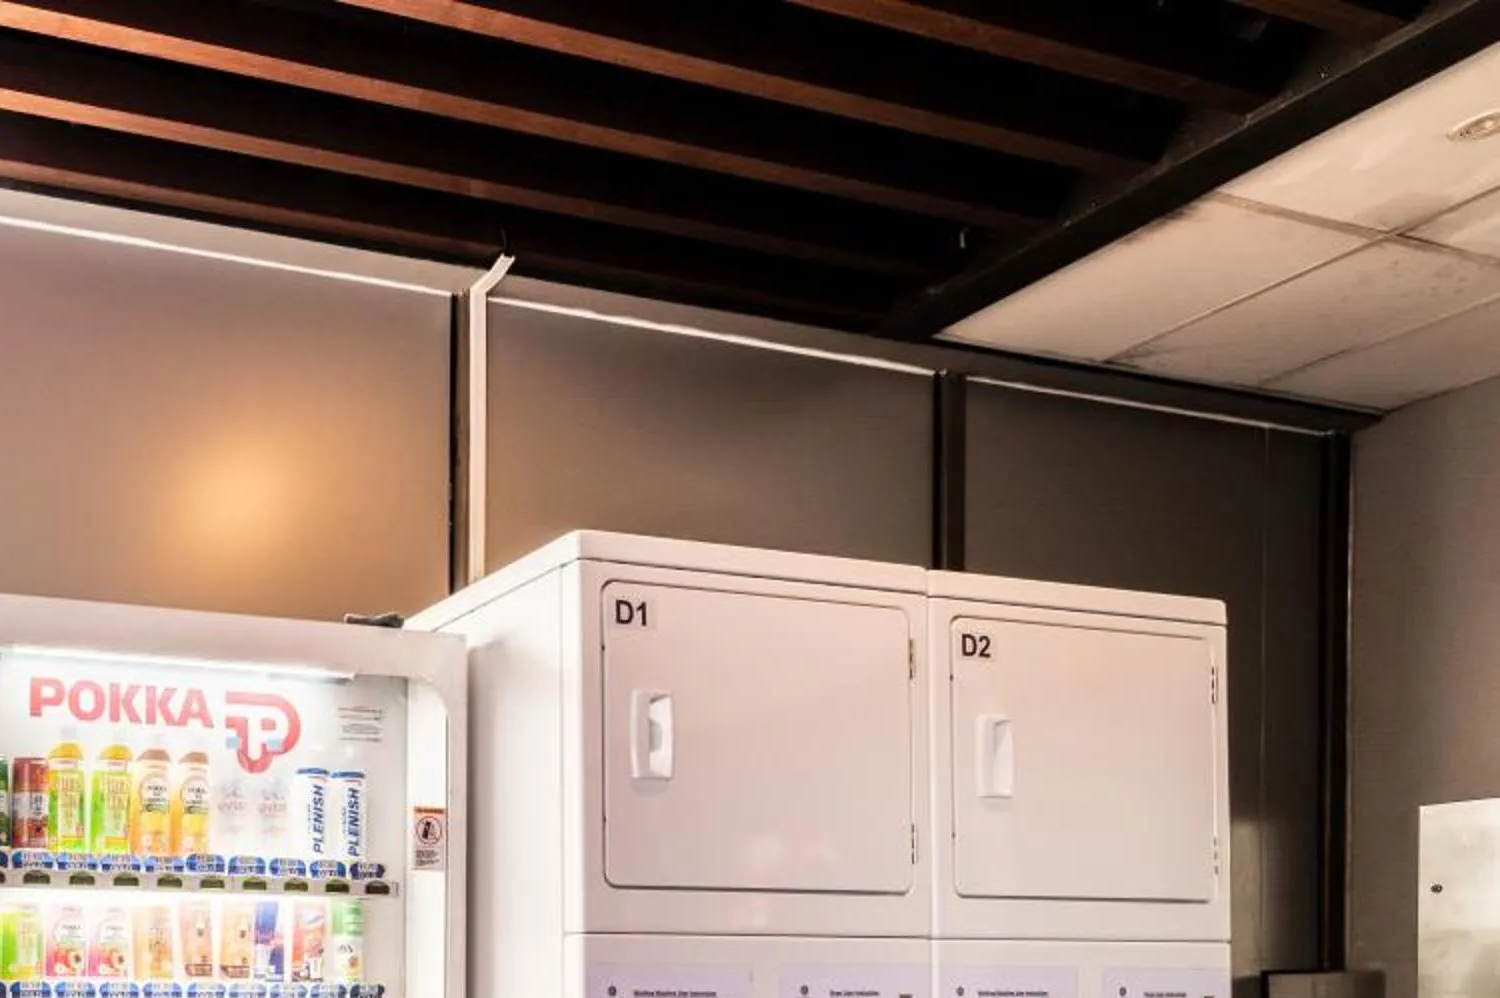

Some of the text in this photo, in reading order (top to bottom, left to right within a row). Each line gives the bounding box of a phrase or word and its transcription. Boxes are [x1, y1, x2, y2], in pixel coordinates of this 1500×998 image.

[614, 600, 649, 627] D1
[961, 633, 992, 659] D2
[29, 677, 214, 729] POKKA
[311, 784, 325, 854] PLENISH
[346, 788, 361, 857] PLENISH
